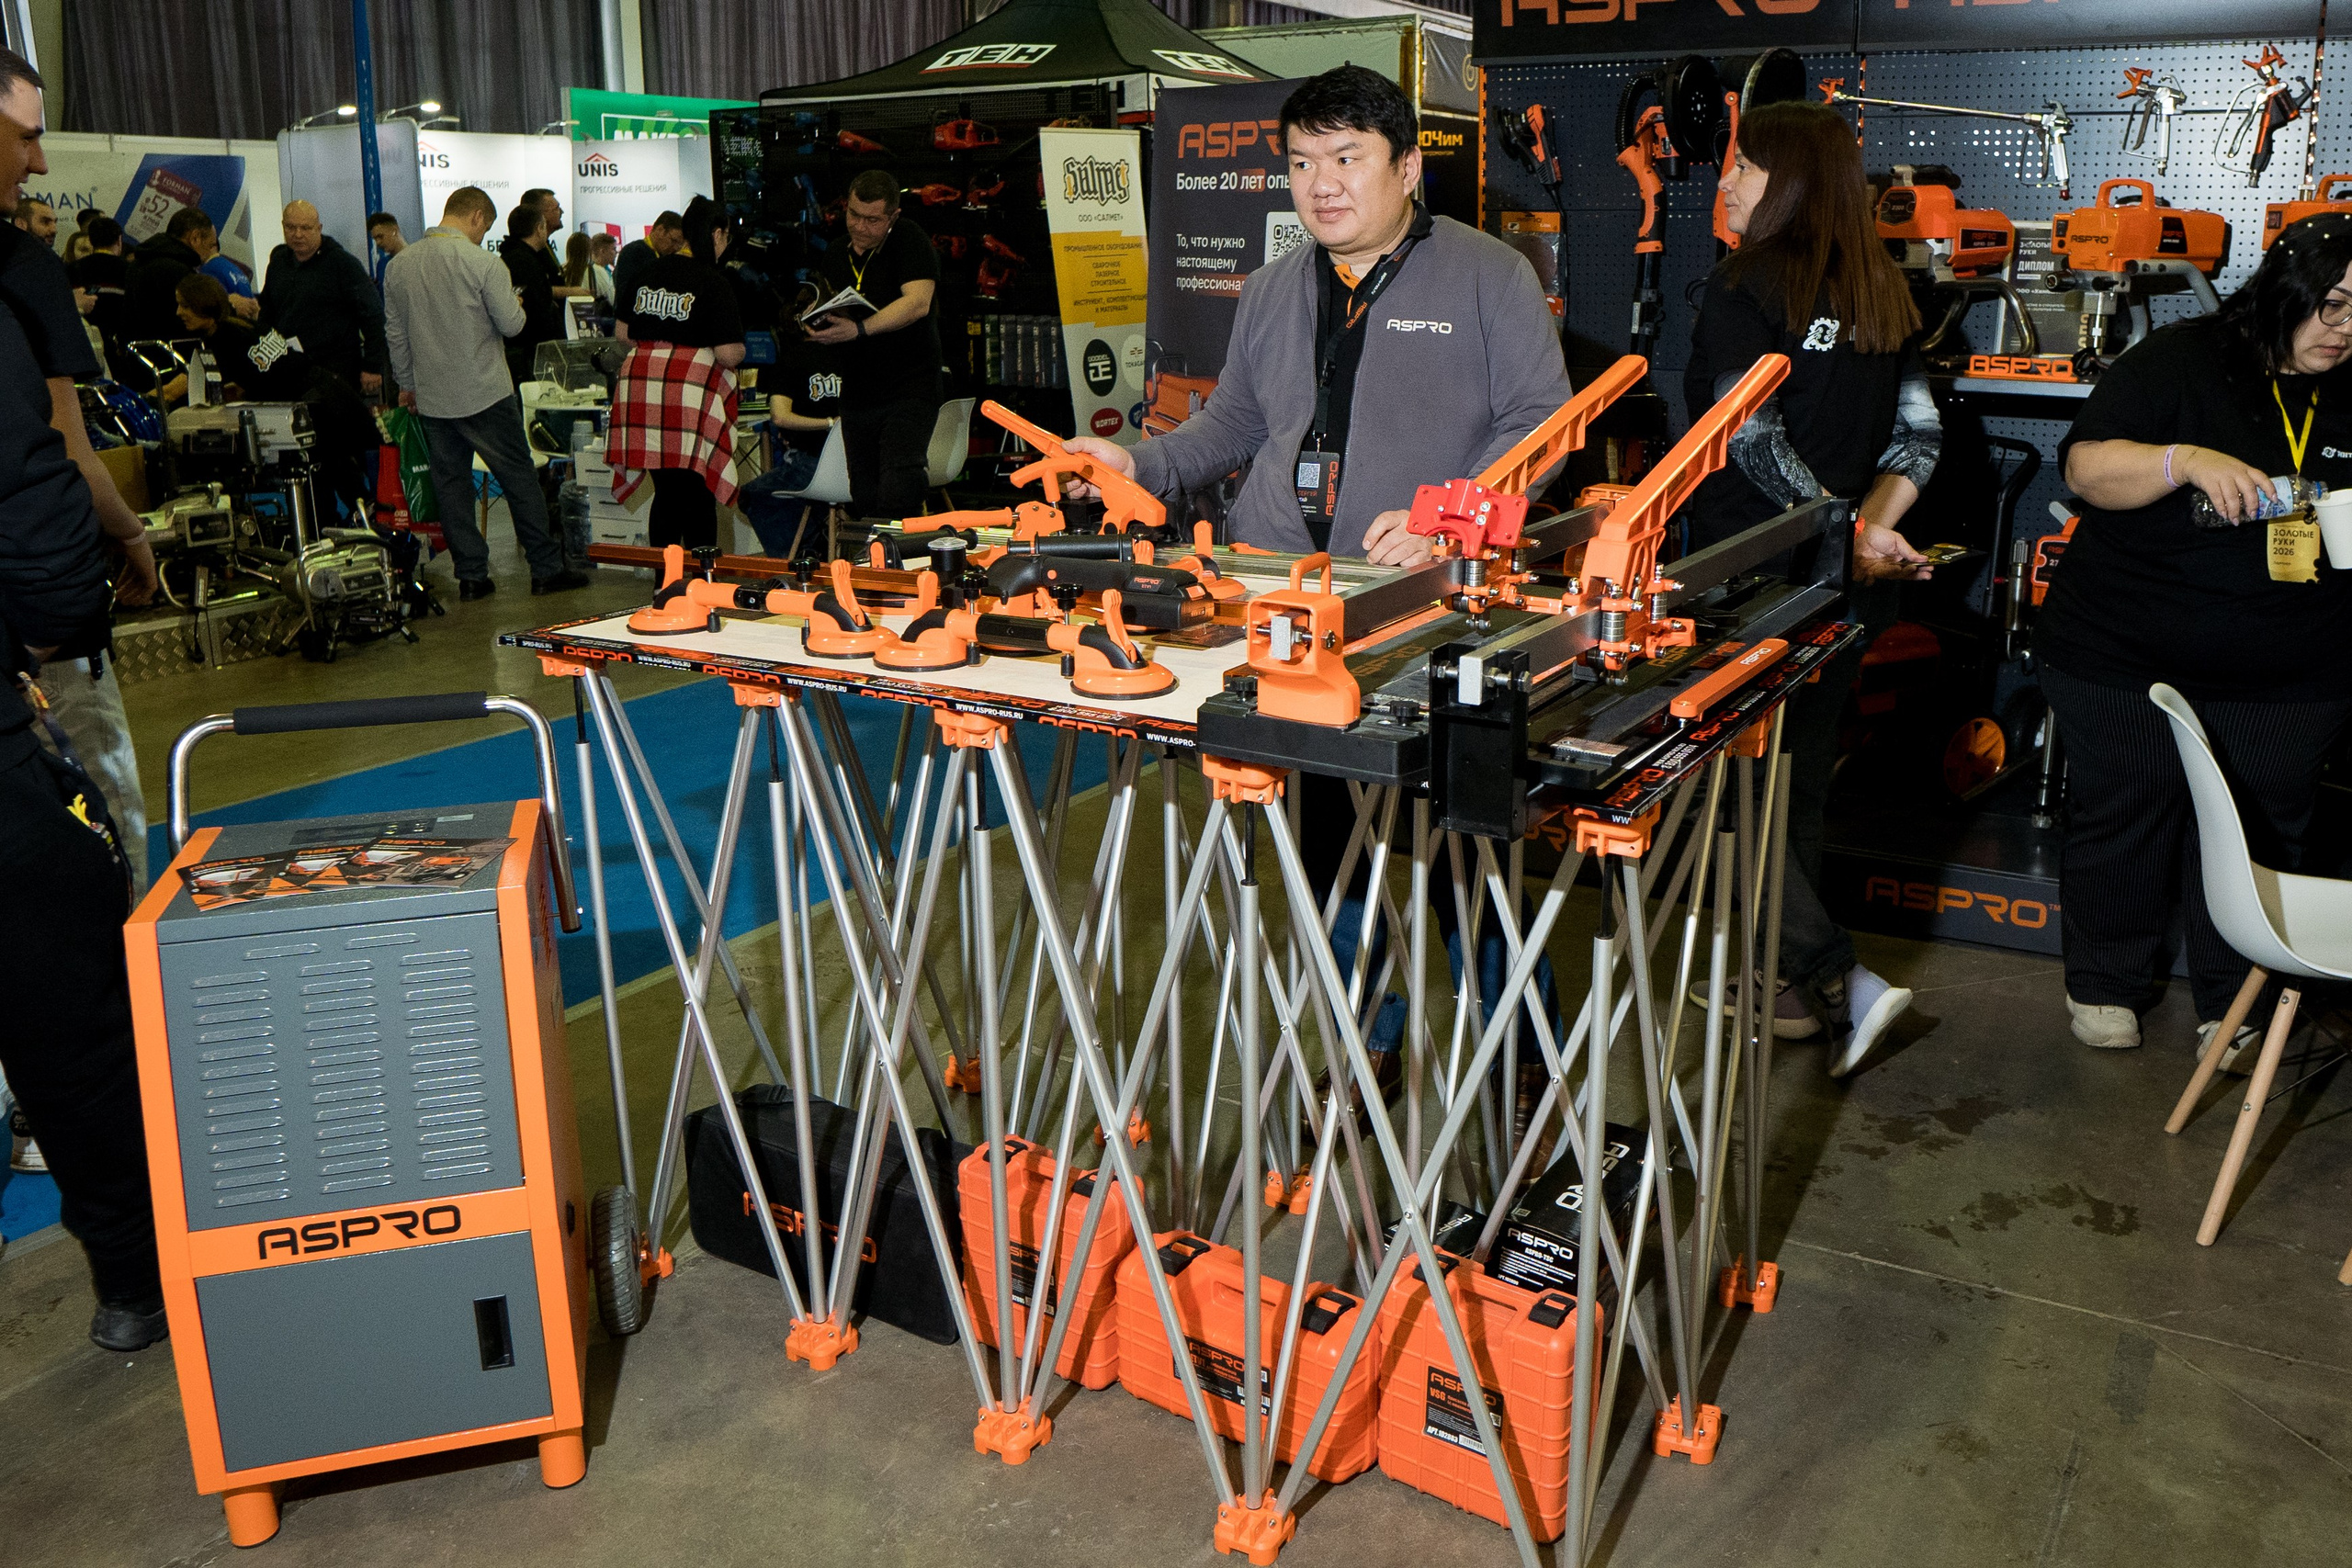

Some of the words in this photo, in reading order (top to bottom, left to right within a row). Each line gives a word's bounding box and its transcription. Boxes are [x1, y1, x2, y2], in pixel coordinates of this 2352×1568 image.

[1178, 119, 1283, 158] ASPR
[1418, 130, 1463, 147] ЮЧим
[418, 153, 450, 169] NIS
[578, 164, 619, 177] UNIS
[1176, 174, 1217, 190] Более
[1219, 172, 1238, 189] 20
[1240, 175, 1264, 190] лет
[1176, 234, 1189, 249] То,
[1192, 236, 1208, 248] что
[1210, 236, 1246, 251] нужно
[2070, 235, 2110, 244] ASPRO
[1176, 256, 1238, 273] настоящему
[2018, 260, 2055, 273] ДИПЛОМ
[1386, 318, 1453, 334] ASPRO
[1969, 355, 2074, 377] ASPRO
[1325, 461, 1339, 516] ASPRO
[2273, 528, 2314, 538] ЗОЛОТЫЕ
[2273, 537, 2295, 546] РУКИ
[2273, 547, 2295, 556] 2026
[786, 676, 848, 694] WWW.ASPRO-RUS.RU
[956, 703, 1024, 721] WWW.ASPRO-RUS.RU
[1146, 732, 1197, 748] WWW.ASPRO-
[257, 1204, 461, 1260] ASPRO
[1507, 1227, 1574, 1260] ASPRO
[1189, 1341, 1245, 1372] ASPRO
